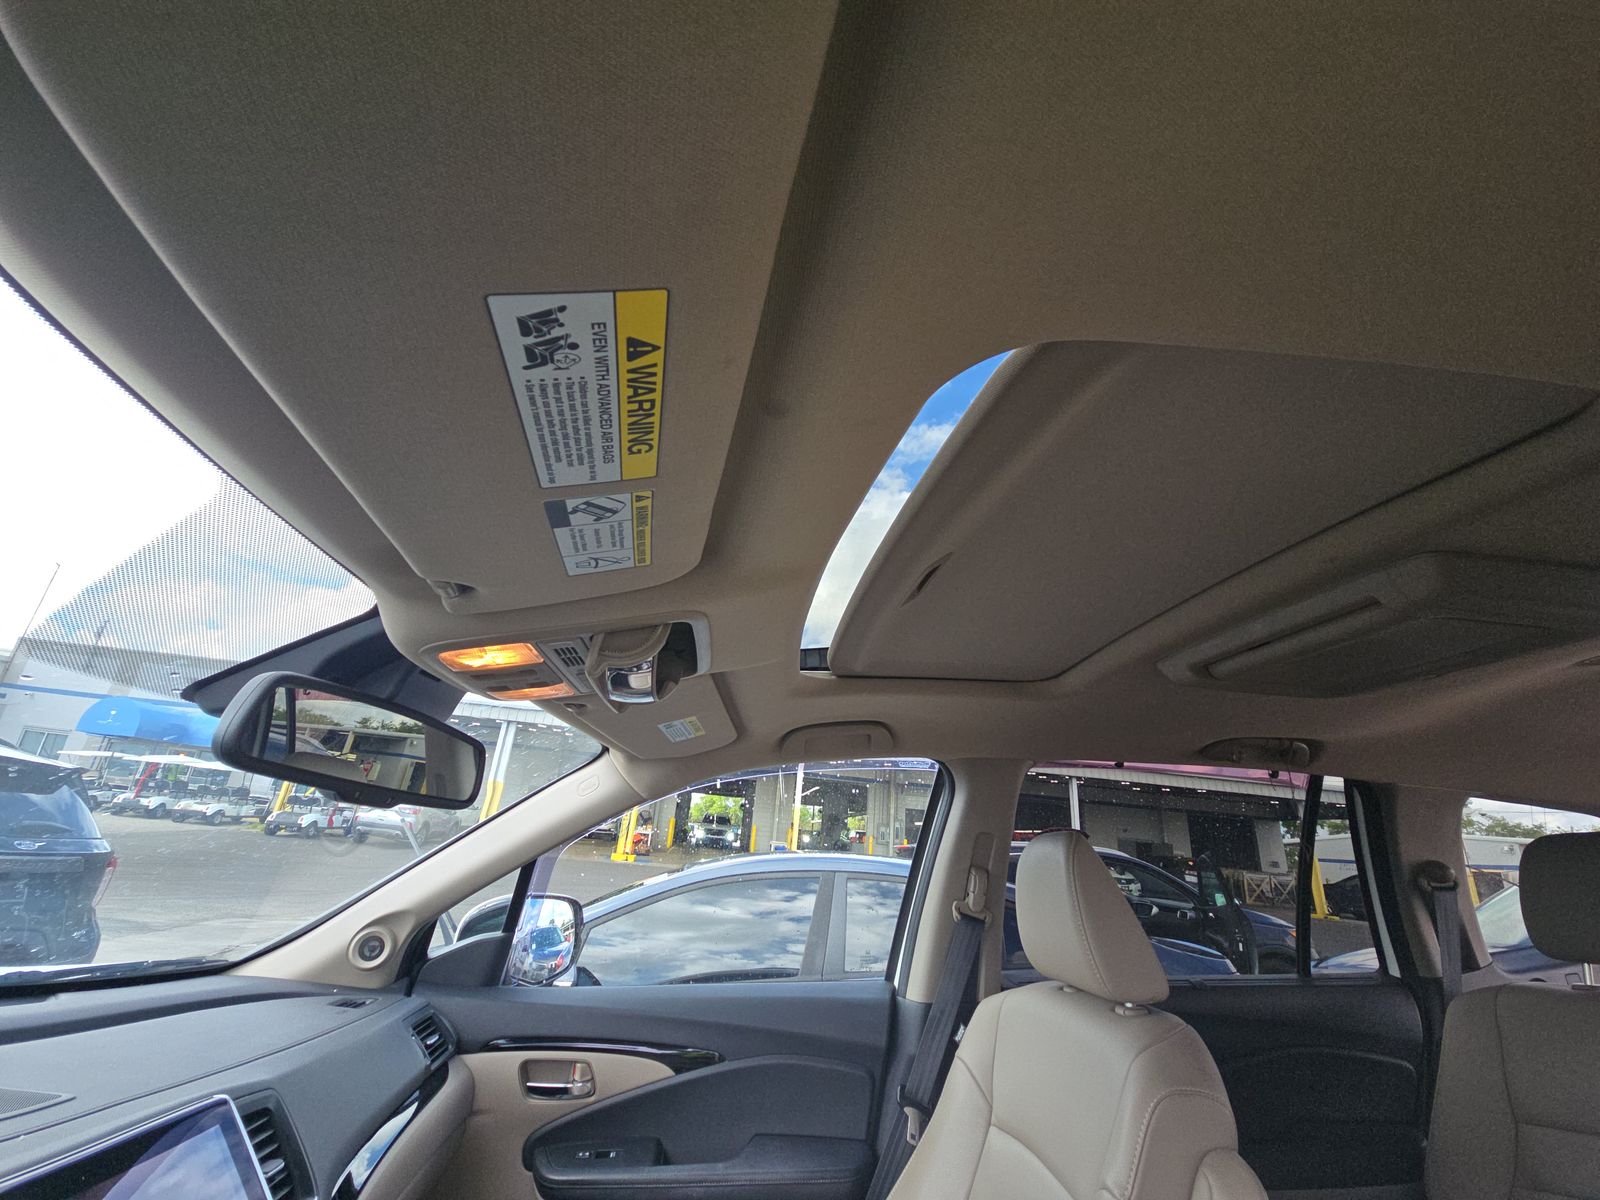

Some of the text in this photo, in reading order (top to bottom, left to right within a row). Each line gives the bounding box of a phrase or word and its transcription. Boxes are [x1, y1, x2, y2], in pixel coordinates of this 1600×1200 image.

[591, 322, 615, 464] EVEN WITH ADVANCED AIR BAGS
[626, 363, 658, 455] WARNING
